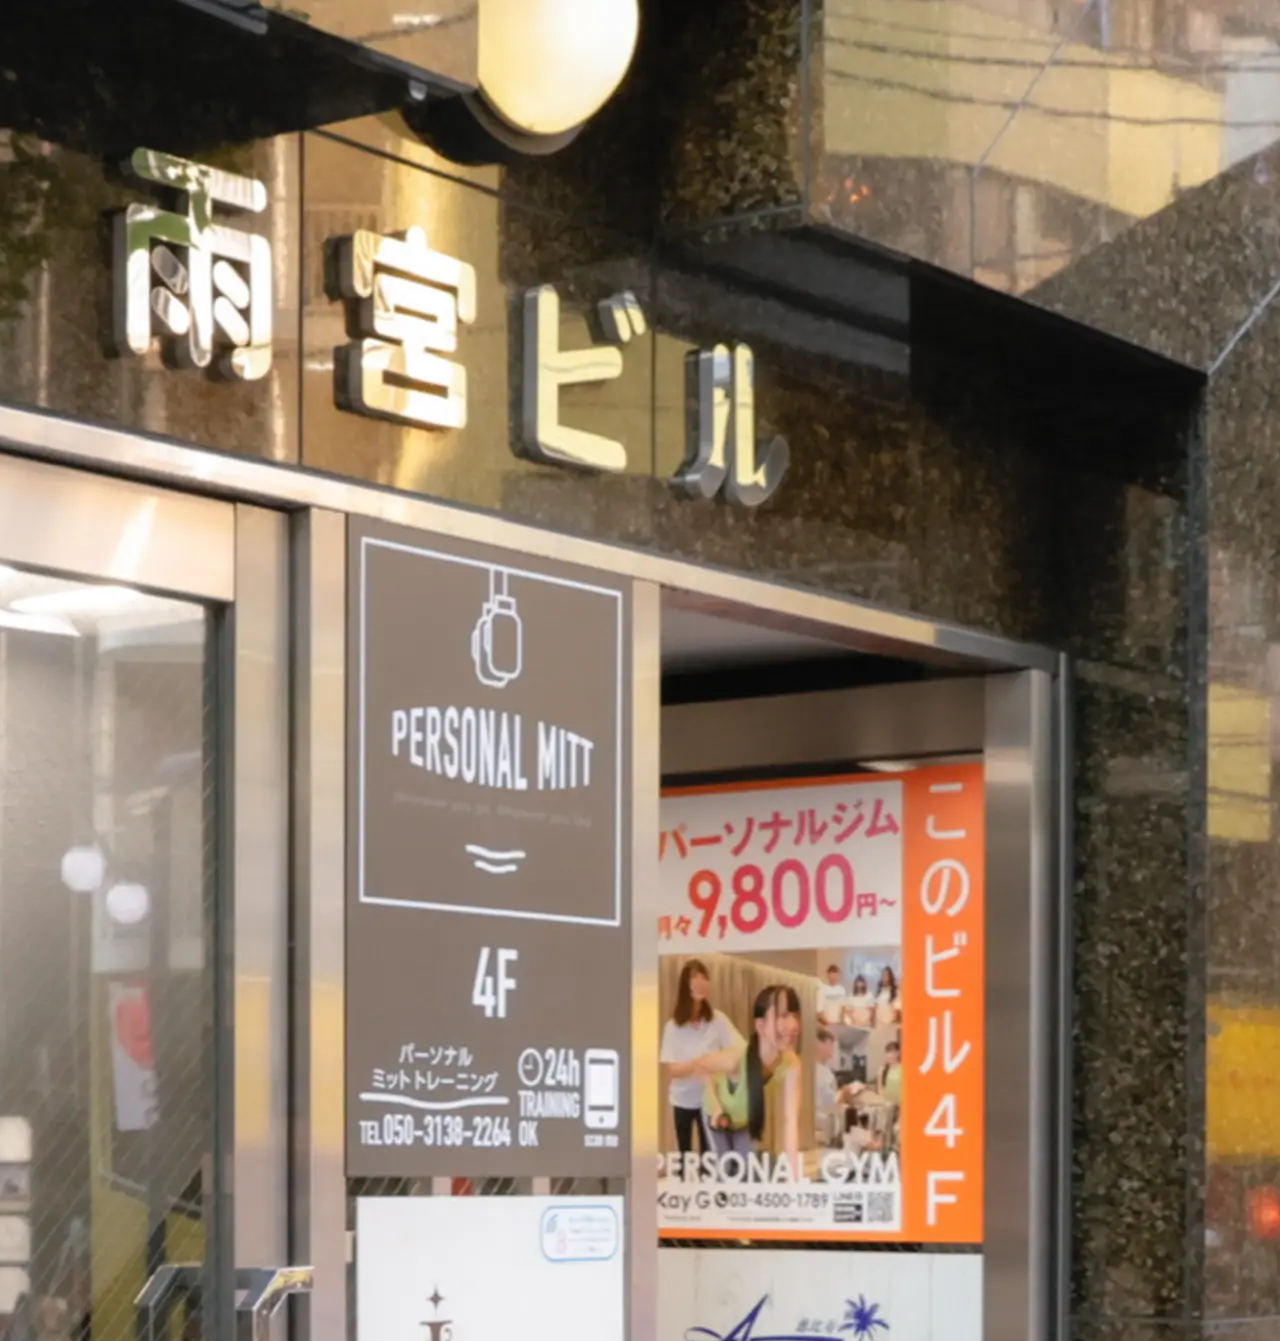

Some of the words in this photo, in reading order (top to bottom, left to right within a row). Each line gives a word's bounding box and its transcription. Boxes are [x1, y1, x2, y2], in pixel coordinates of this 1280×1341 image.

[122, 147, 784, 506] 雨宮ビル
[391, 705, 528, 791] PERSONAL
[537, 720, 595, 791] MITT
[658, 798, 901, 862] パーソナルジム
[471, 945, 519, 1019] 4F
[919, 781, 971, 1227] このビル4F
[398, 1043, 474, 1066] パーソナル
[544, 1047, 580, 1087] 24h
[517, 1090, 580, 1119] TRAINING
[518, 1120, 539, 1147] OK
[821, 1151, 901, 1185] GYM
[694, 1190, 712, 1210] G
